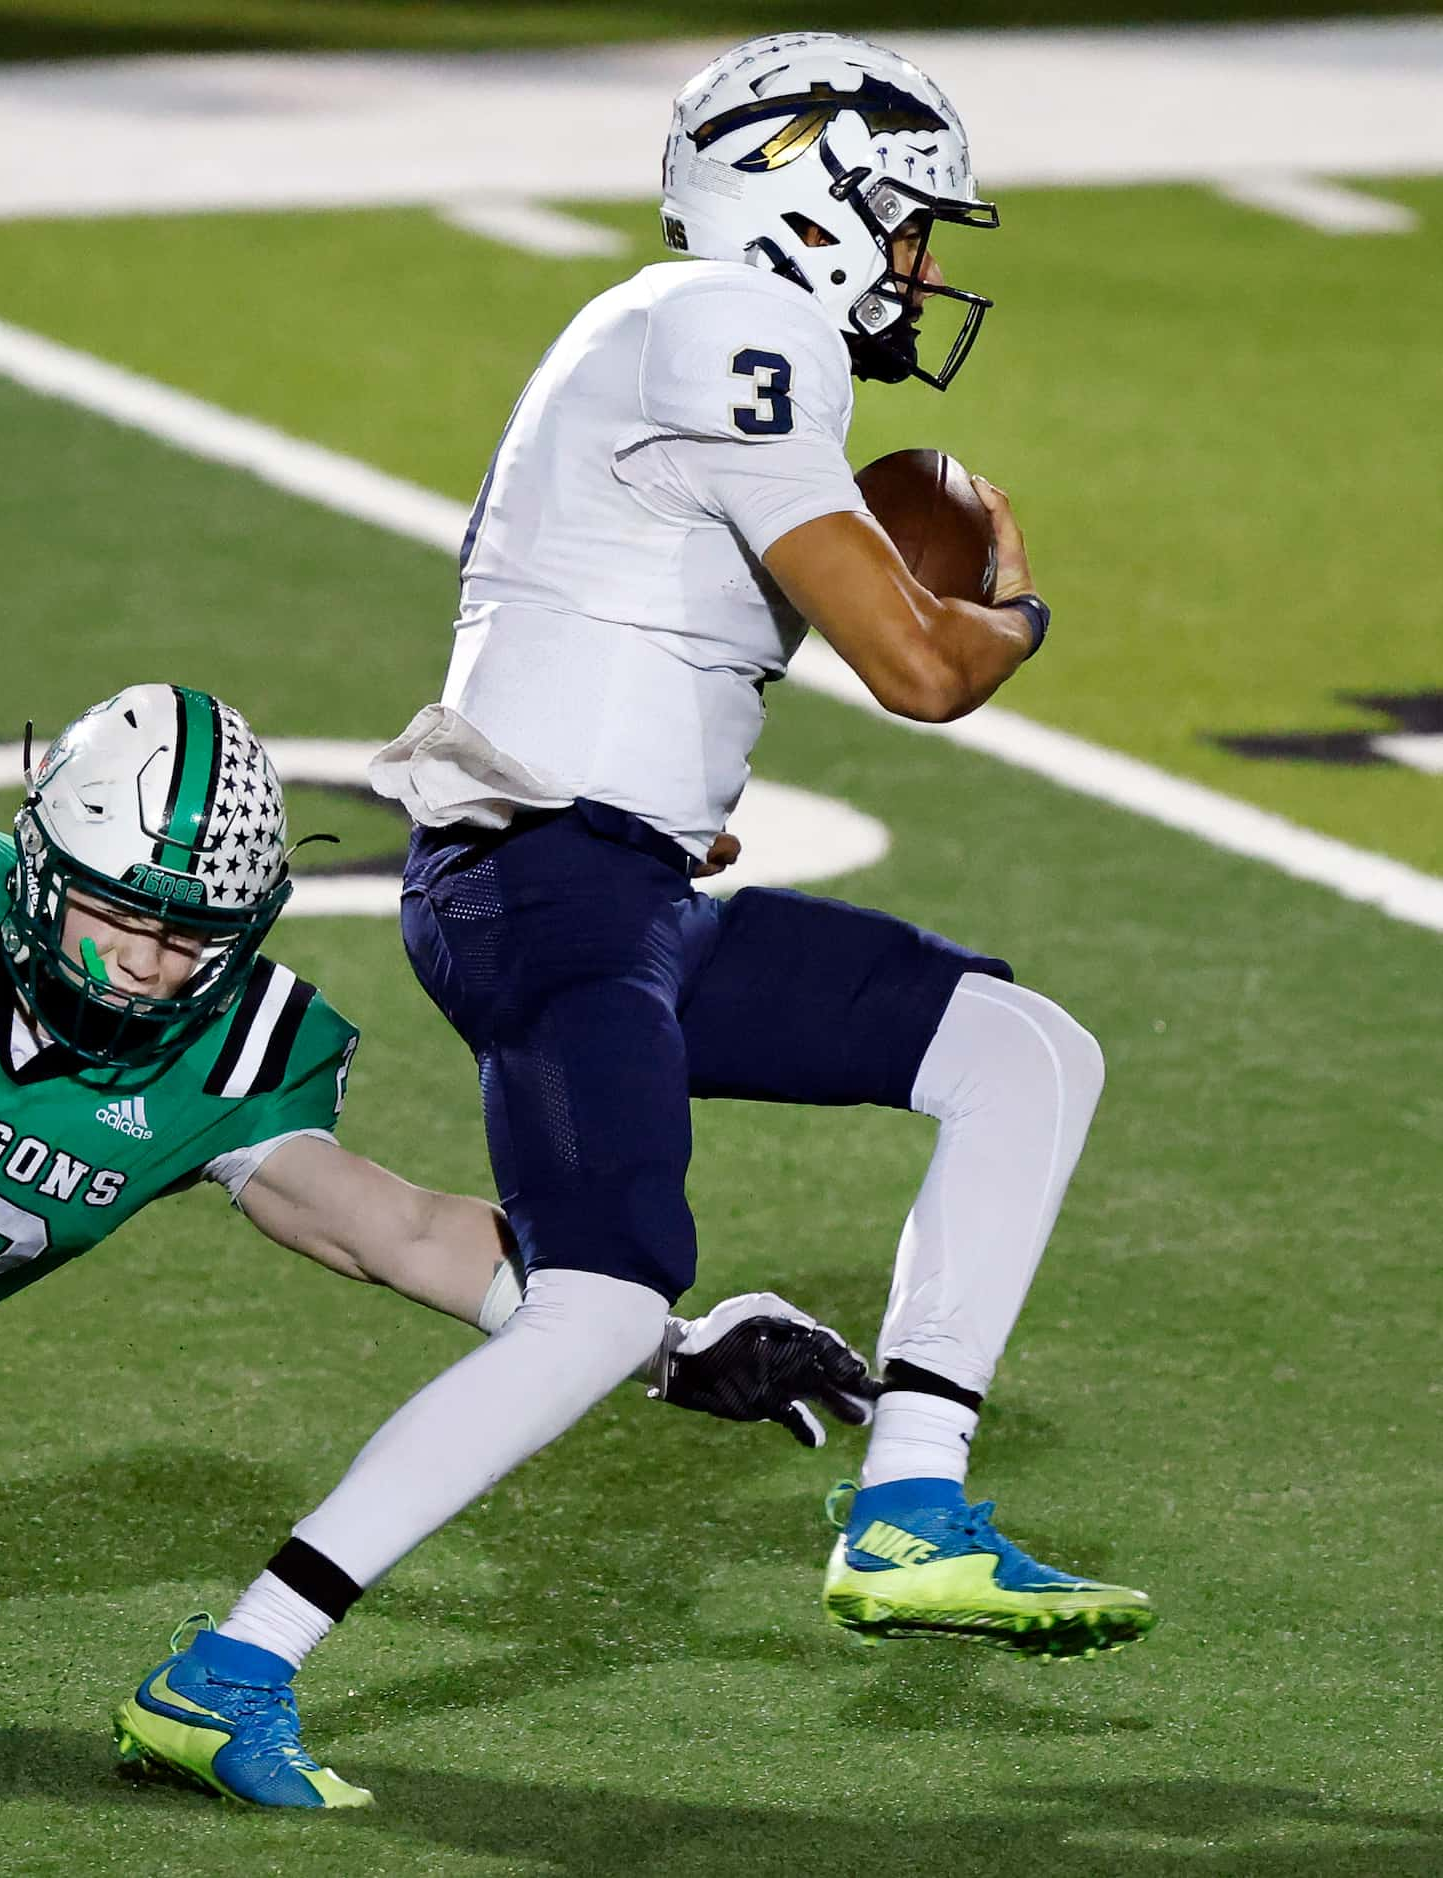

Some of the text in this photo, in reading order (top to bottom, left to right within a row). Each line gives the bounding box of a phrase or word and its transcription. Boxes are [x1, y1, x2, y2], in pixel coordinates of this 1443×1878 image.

[728, 344, 796, 438] 3
[130, 865, 206, 905] 76092
[95, 1108, 154, 1140] adidas
